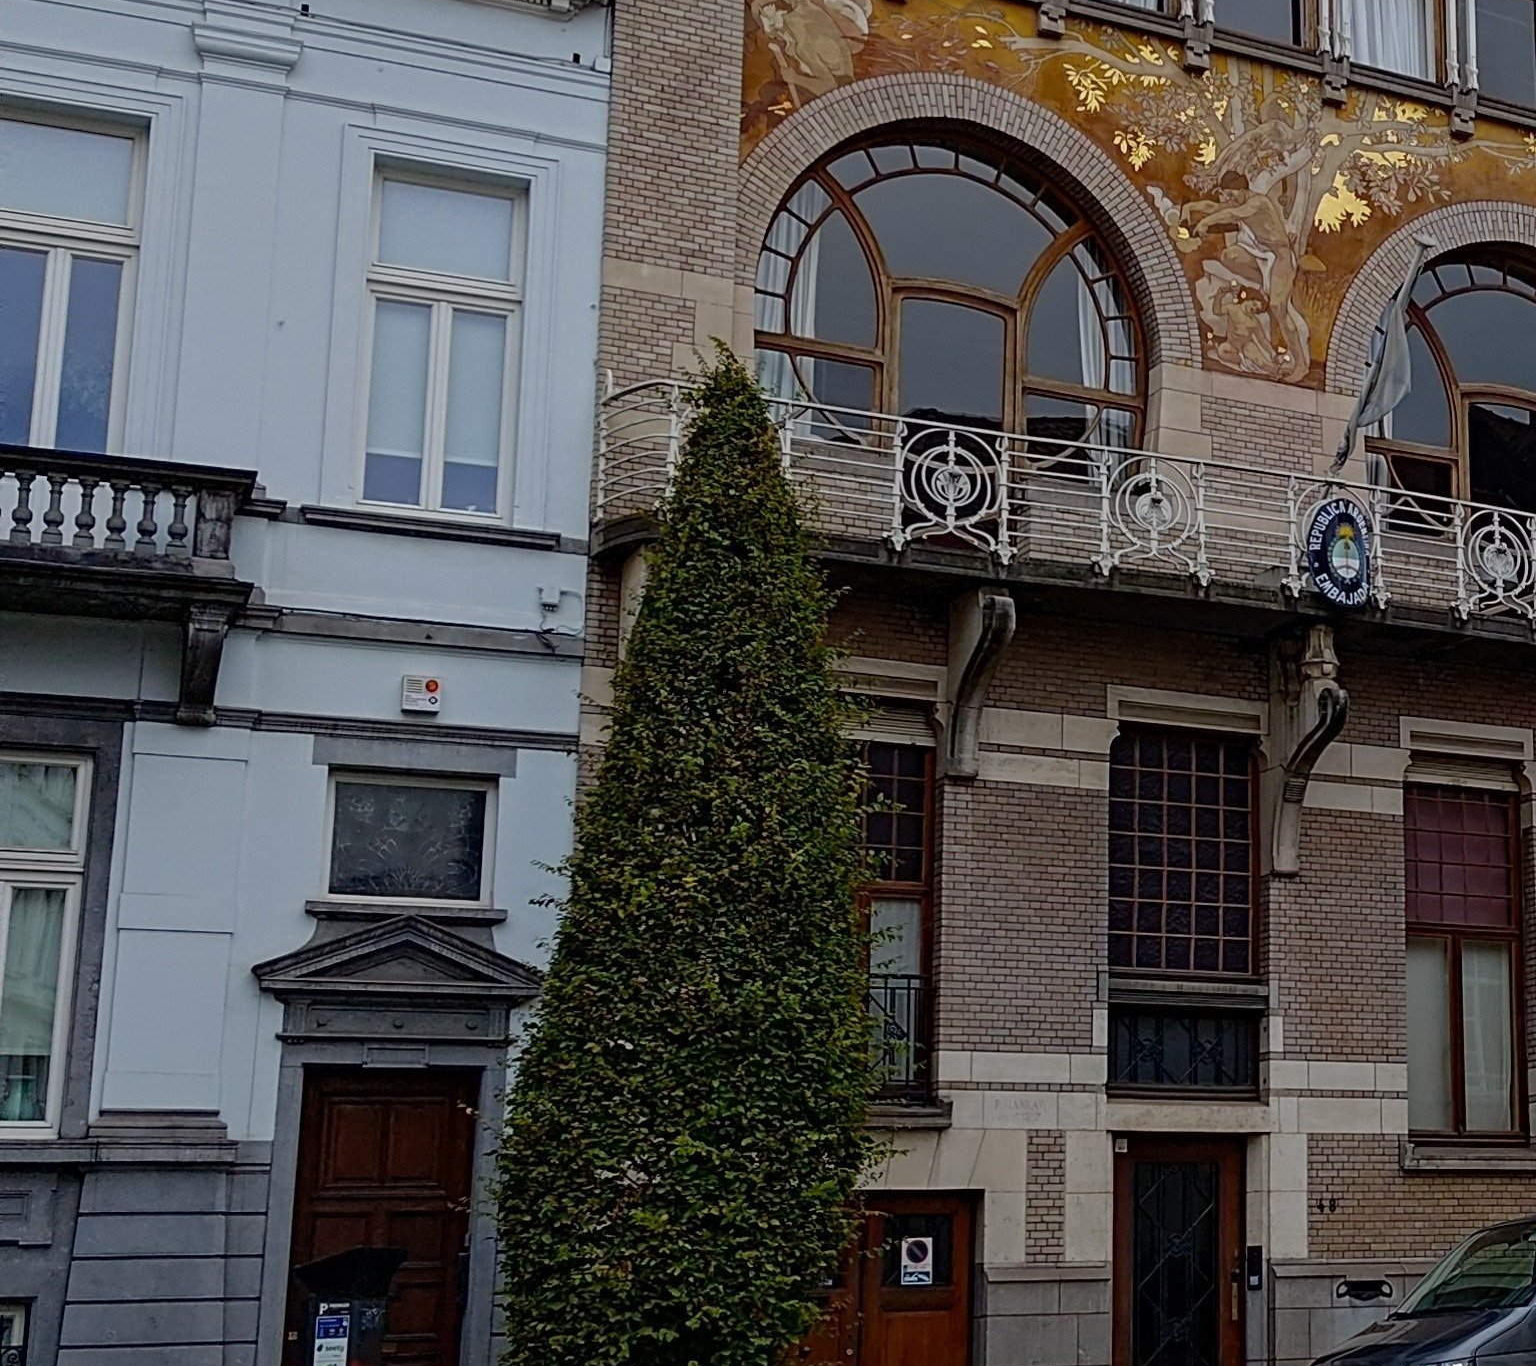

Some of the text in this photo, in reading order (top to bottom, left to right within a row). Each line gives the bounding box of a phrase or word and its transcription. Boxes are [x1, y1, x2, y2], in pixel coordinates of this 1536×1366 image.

[1309, 500, 1346, 551] REPUBLICA
[1315, 572, 1370, 606] EMBAJADA
[1316, 1197, 1337, 1214] 48
